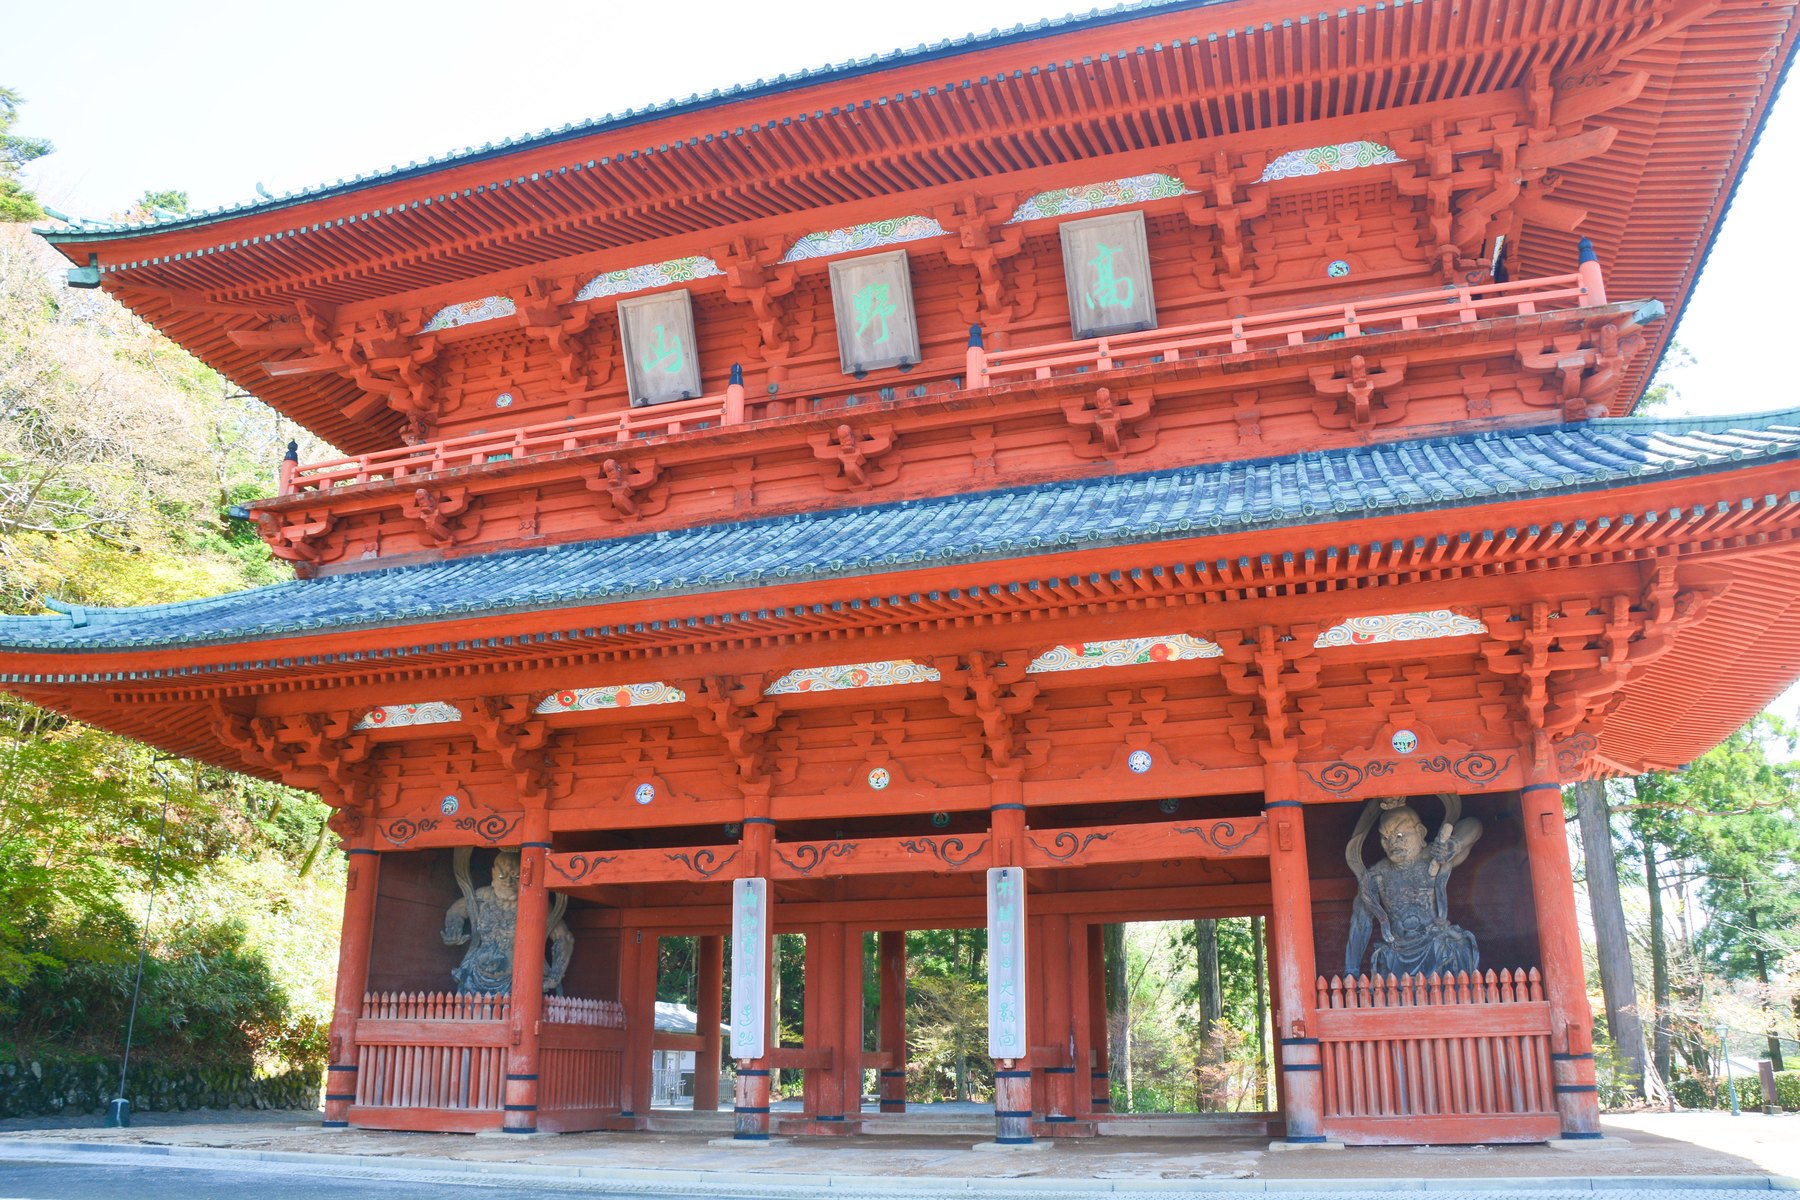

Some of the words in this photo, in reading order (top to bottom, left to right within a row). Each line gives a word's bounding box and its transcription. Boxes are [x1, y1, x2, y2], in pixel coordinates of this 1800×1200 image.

[1086, 242, 1134, 309] 高
[852, 282, 896, 344] 野
[642, 325, 682, 373] 山
